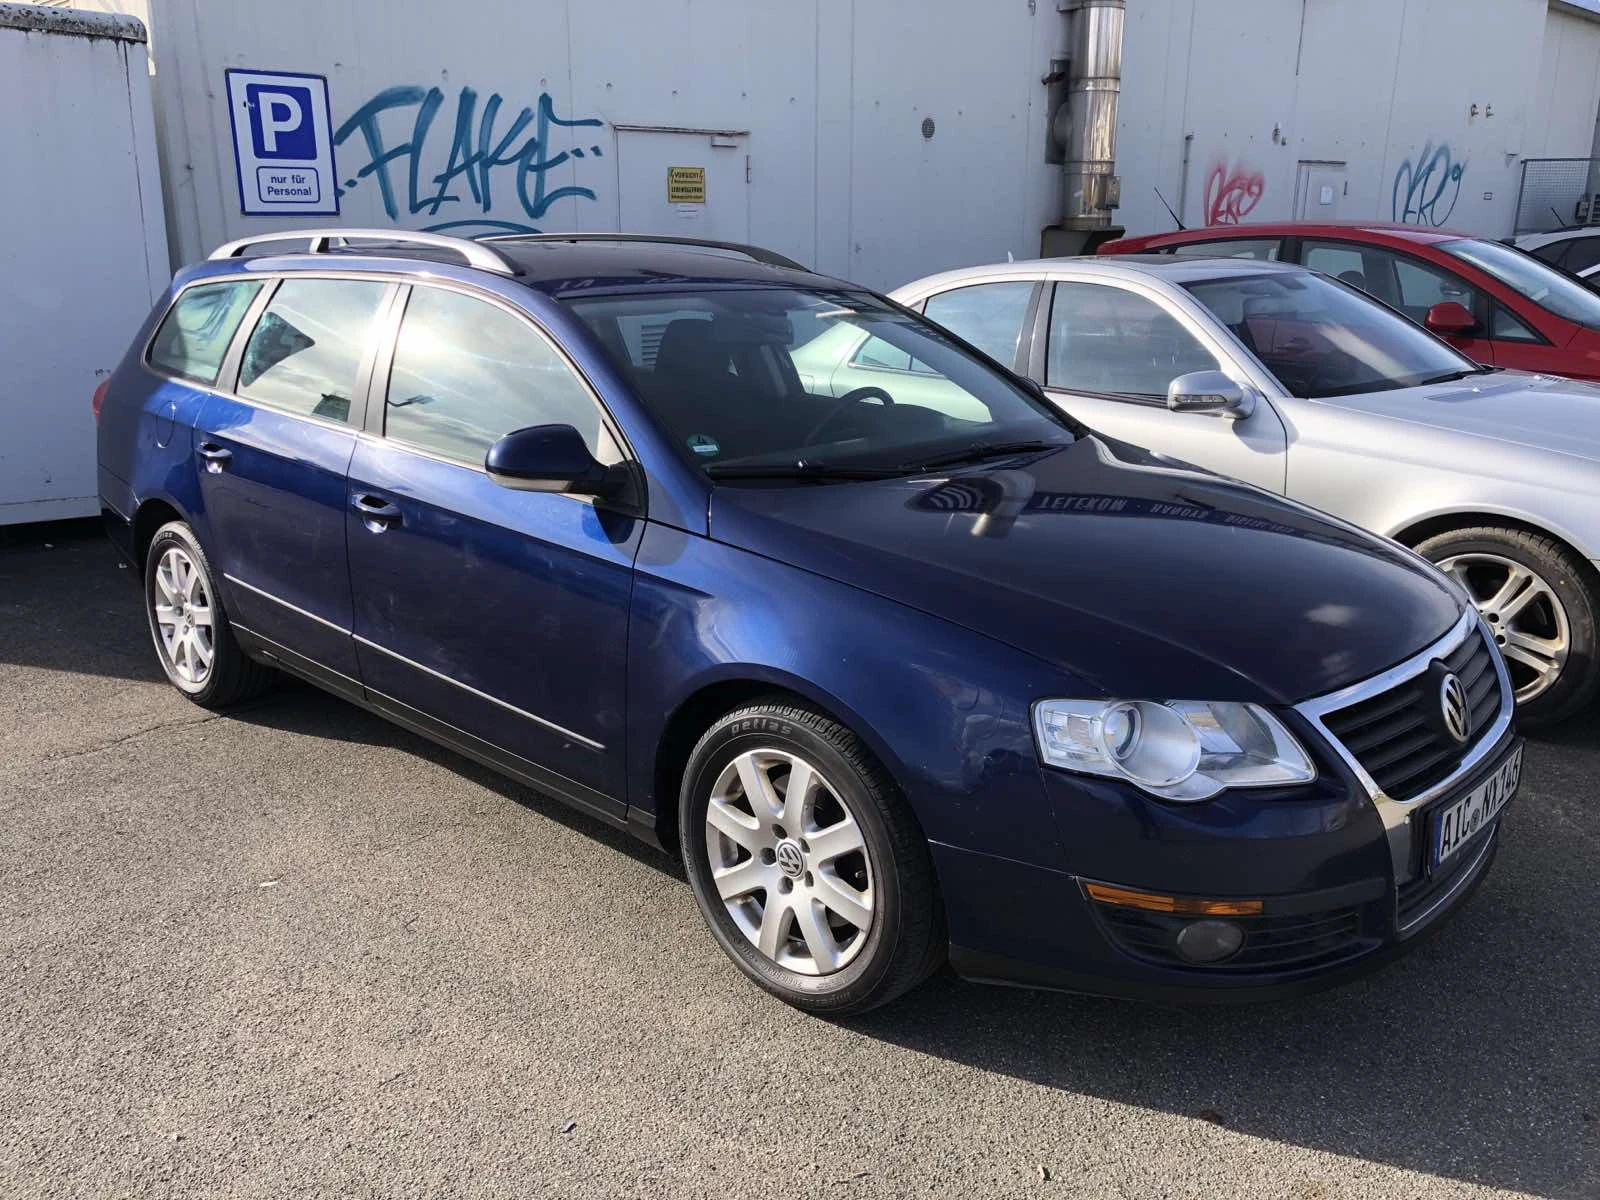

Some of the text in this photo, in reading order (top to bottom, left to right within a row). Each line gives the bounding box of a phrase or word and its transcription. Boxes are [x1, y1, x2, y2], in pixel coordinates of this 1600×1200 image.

[258, 91, 303, 152] P
[266, 186, 312, 197] Personal
[270, 174, 307, 185] nur für
[1441, 796, 1471, 856] AIC
